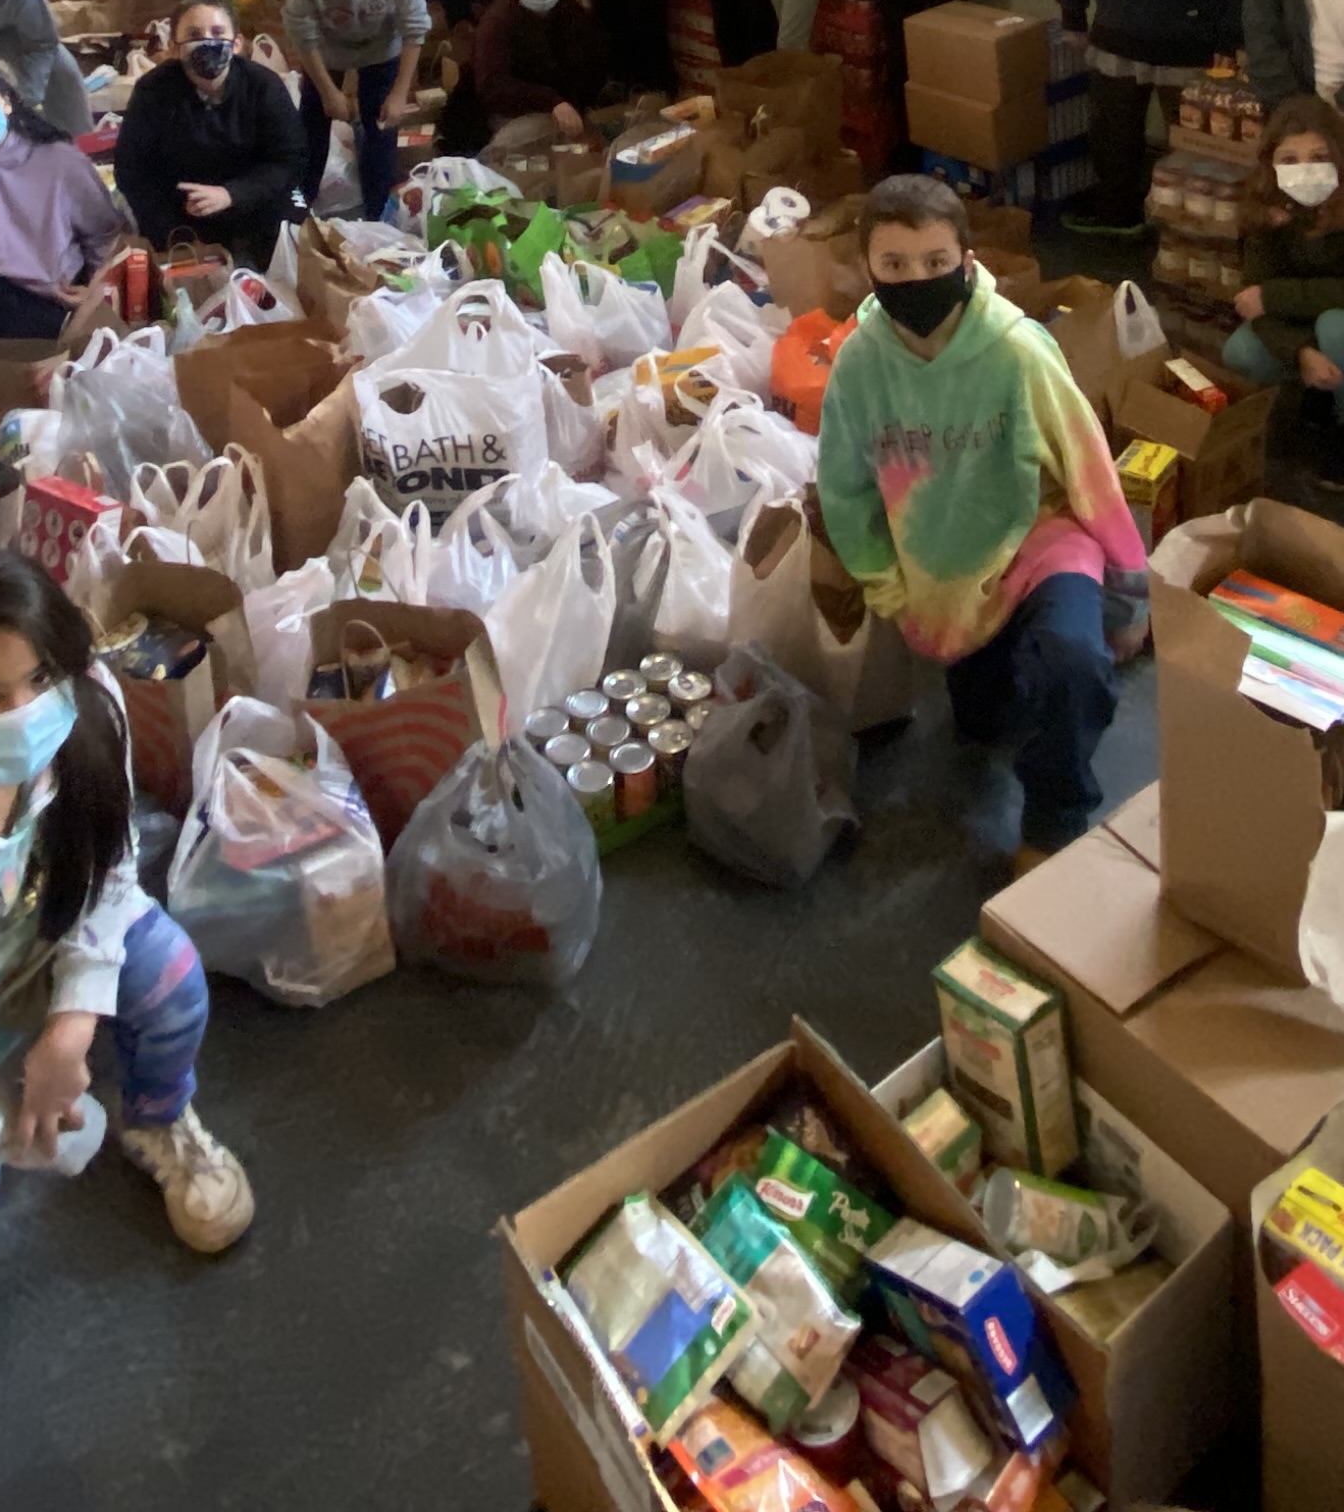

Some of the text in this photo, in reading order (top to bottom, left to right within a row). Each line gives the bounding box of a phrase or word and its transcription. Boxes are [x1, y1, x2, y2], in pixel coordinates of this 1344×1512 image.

[392, 434, 475, 472] BATH
[482, 434, 507, 464] &
[1299, 1220, 1344, 1262] PACK
